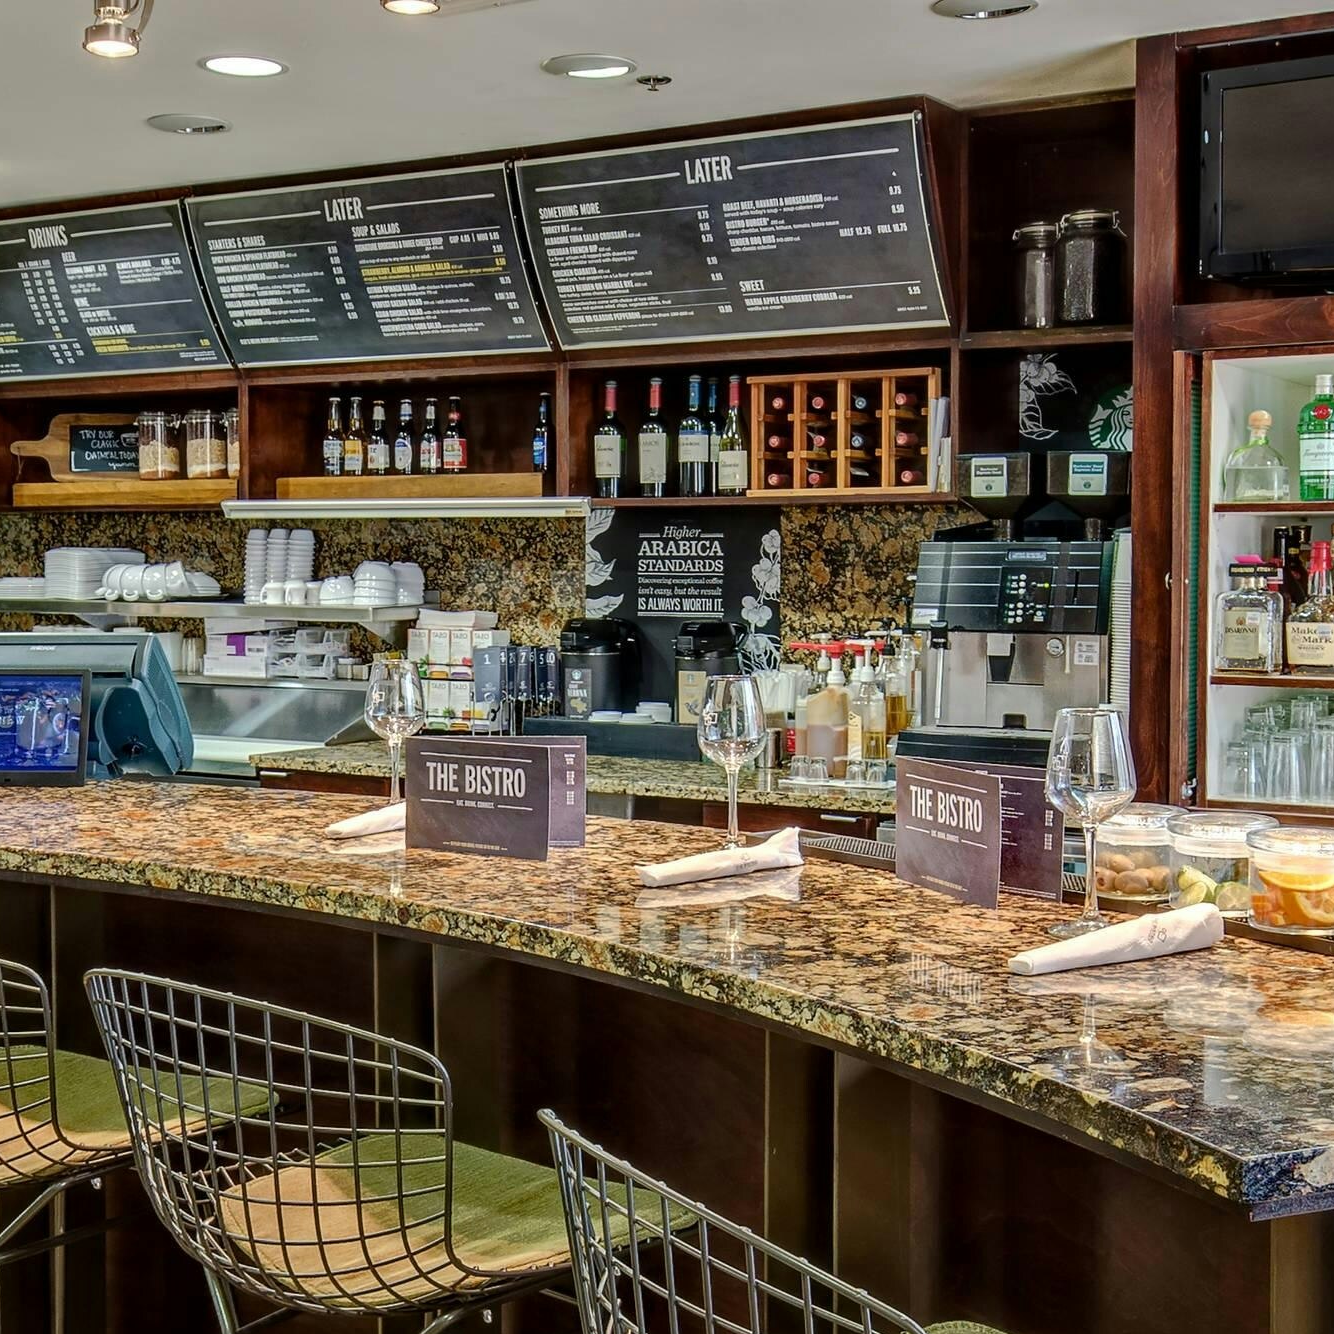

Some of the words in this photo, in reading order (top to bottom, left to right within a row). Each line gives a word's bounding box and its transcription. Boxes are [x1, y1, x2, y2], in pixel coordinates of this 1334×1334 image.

[684, 155, 734, 185] LATER
[323, 197, 364, 222] LATER
[539, 204, 579, 220] SOMETHING
[579, 202, 601, 216] MORE
[28, 225, 68, 250] DRINKS
[351, 226, 369, 238] SOUP
[369, 225, 376, 236] &
[375, 222, 401, 235] SALADS
[207, 238, 237, 251] STARTERS
[241, 235, 266, 247] SHARES
[739, 279, 765, 292] SWEET
[662, 525, 702, 540] Higher
[637, 540, 724, 556] ARABICA
[638, 559, 724, 572] STANDARDS
[638, 577, 672, 585] Discovering
[672, 577, 705, 585] exceptional
[638, 586, 654, 595] isn't
[654, 588, 673, 597] easy,
[674, 586, 687, 595] but
[687, 587, 700, 595] the
[701, 587, 722, 595] result
[638, 597, 647, 610] IS
[647, 597, 681, 611] ALWAYS
[682, 598, 712, 611] WORTH
[714, 598, 725, 612] IT.
[483, 654, 491, 665] 1
[519, 652, 527, 663] 7
[426, 761, 459, 793] THE
[465, 764, 526, 799] BISTRO
[909, 785, 934, 821] THE
[937, 791, 982, 833] BISTRO
